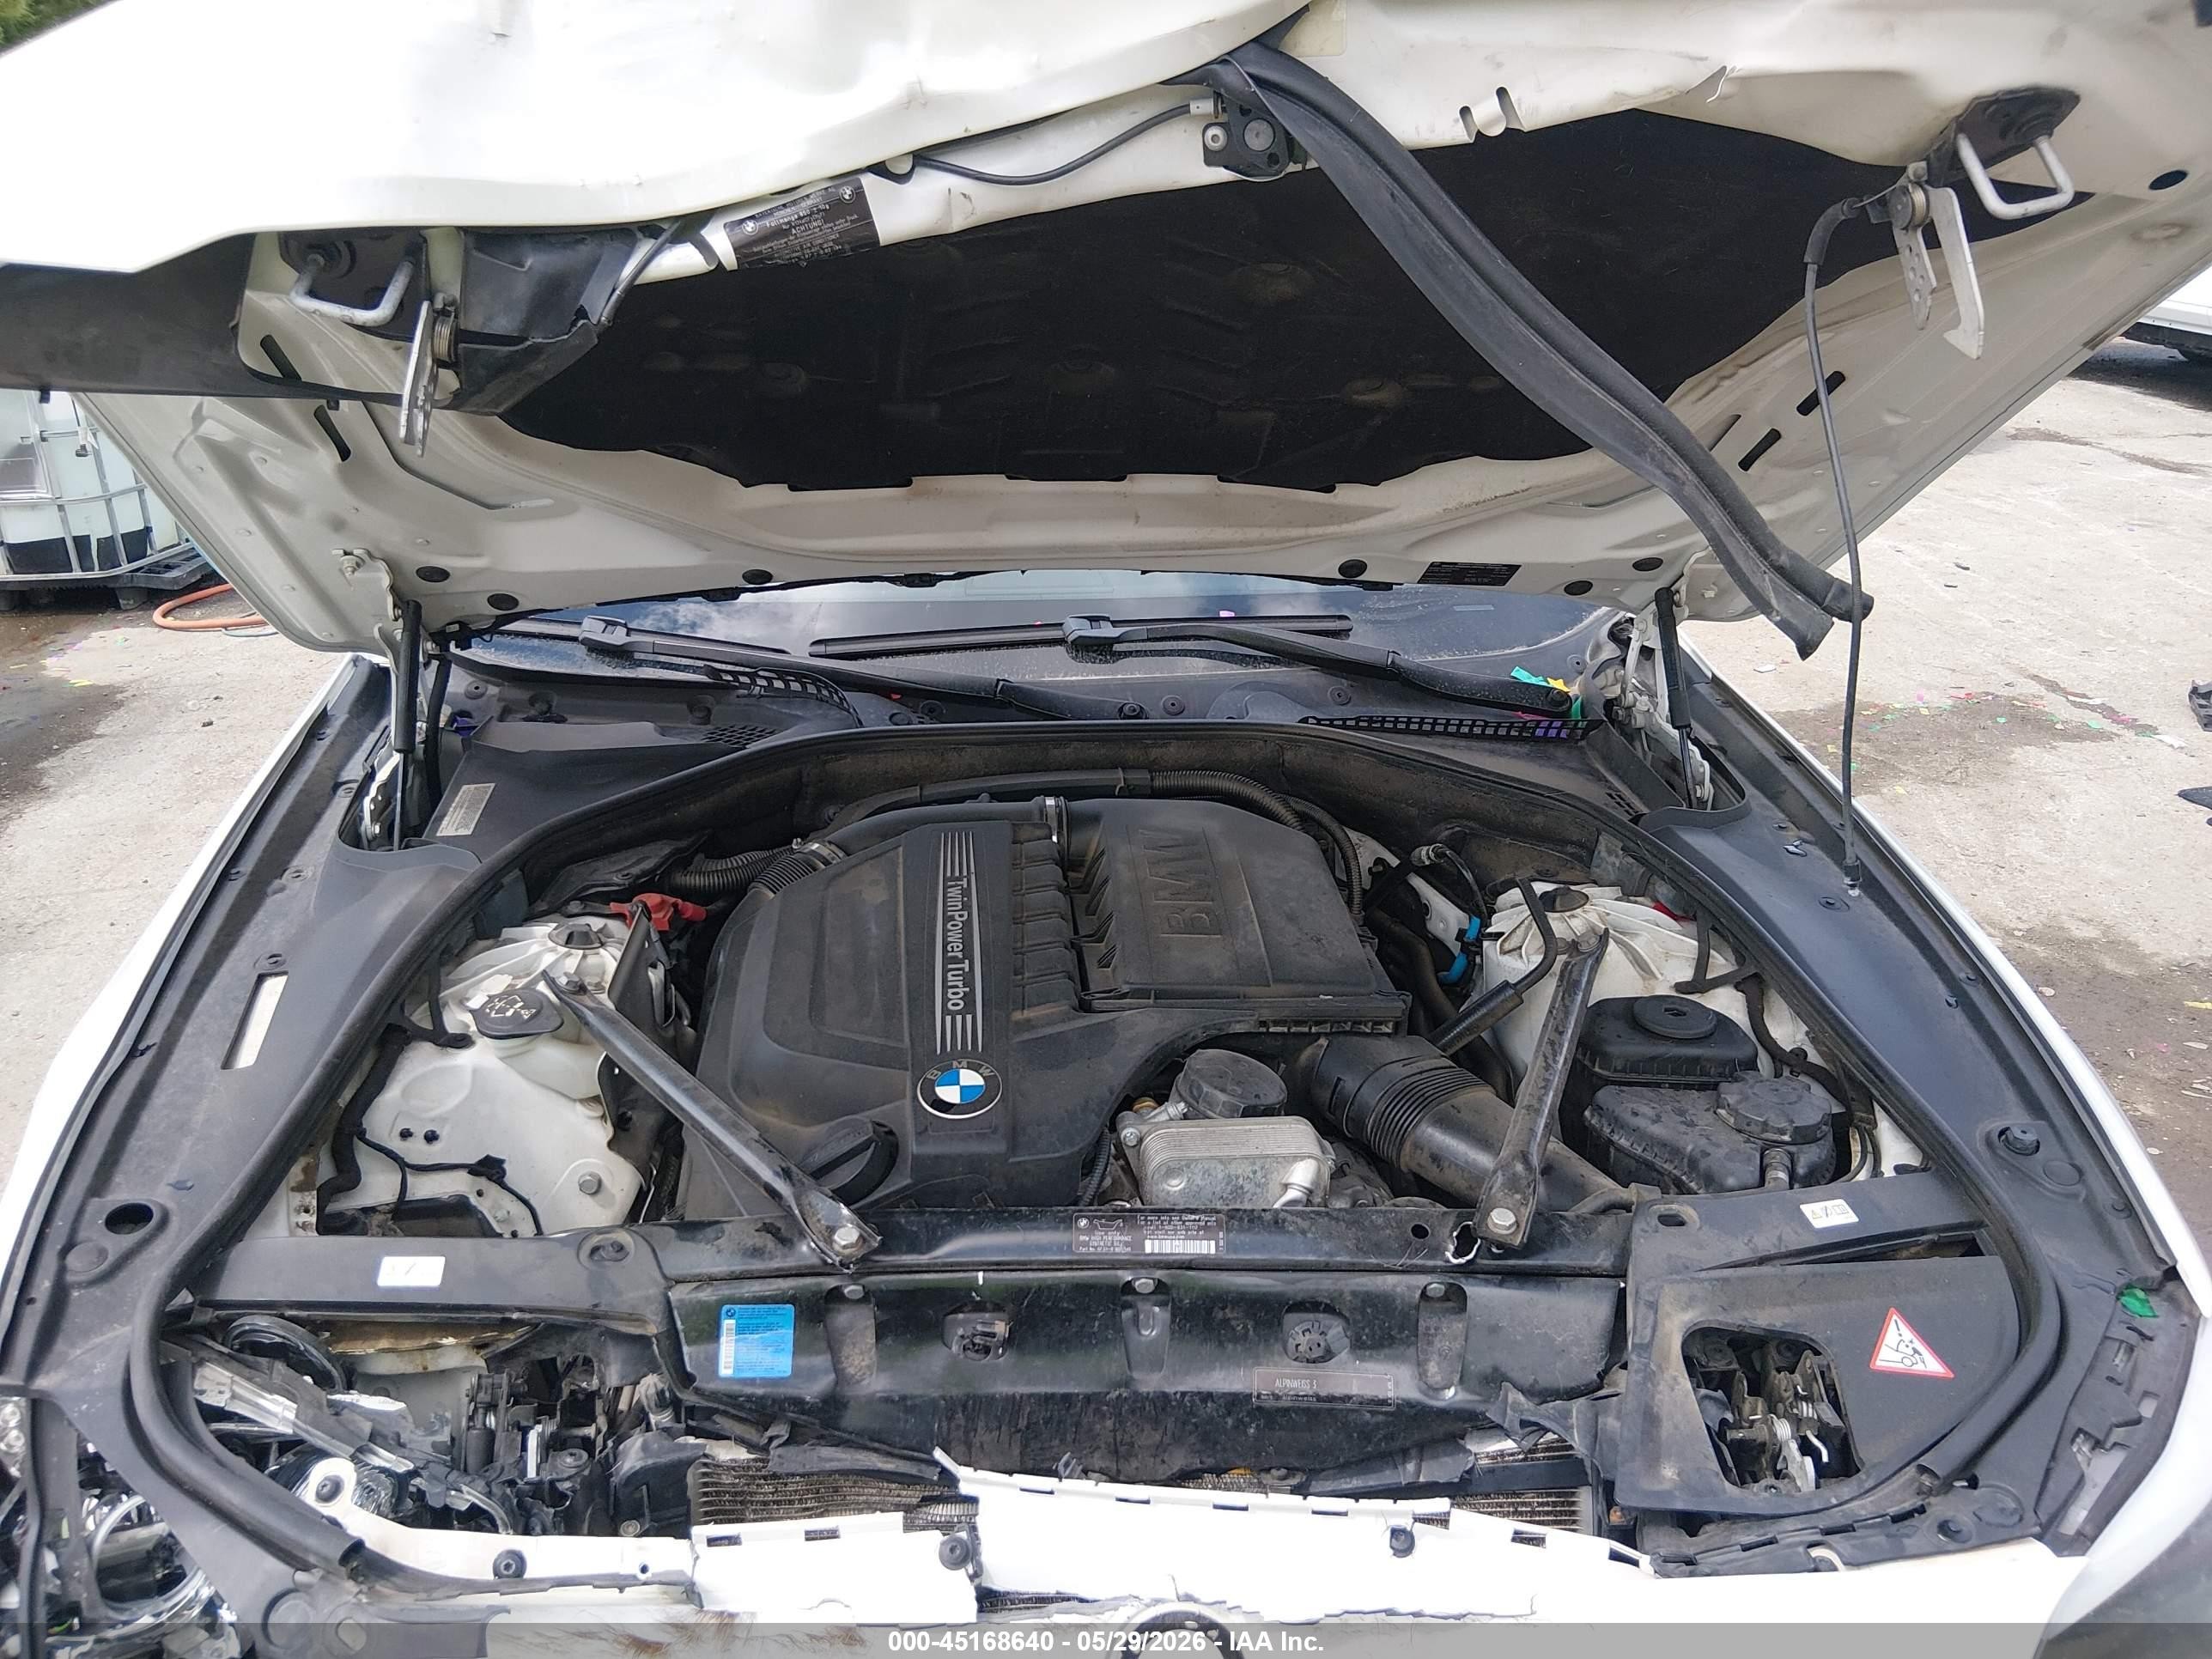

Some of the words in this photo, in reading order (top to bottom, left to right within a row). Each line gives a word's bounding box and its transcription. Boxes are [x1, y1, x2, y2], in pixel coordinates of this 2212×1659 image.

[792, 218, 824, 235] ACHTUNG!
[1139, 829, 1223, 938] BMW
[947, 878, 969, 958] TwinPower
[947, 959, 970, 1011] Turbo
[927, 1060, 995, 1080] BMW
[1275, 1377, 1310, 1389] ALPINWEISS
